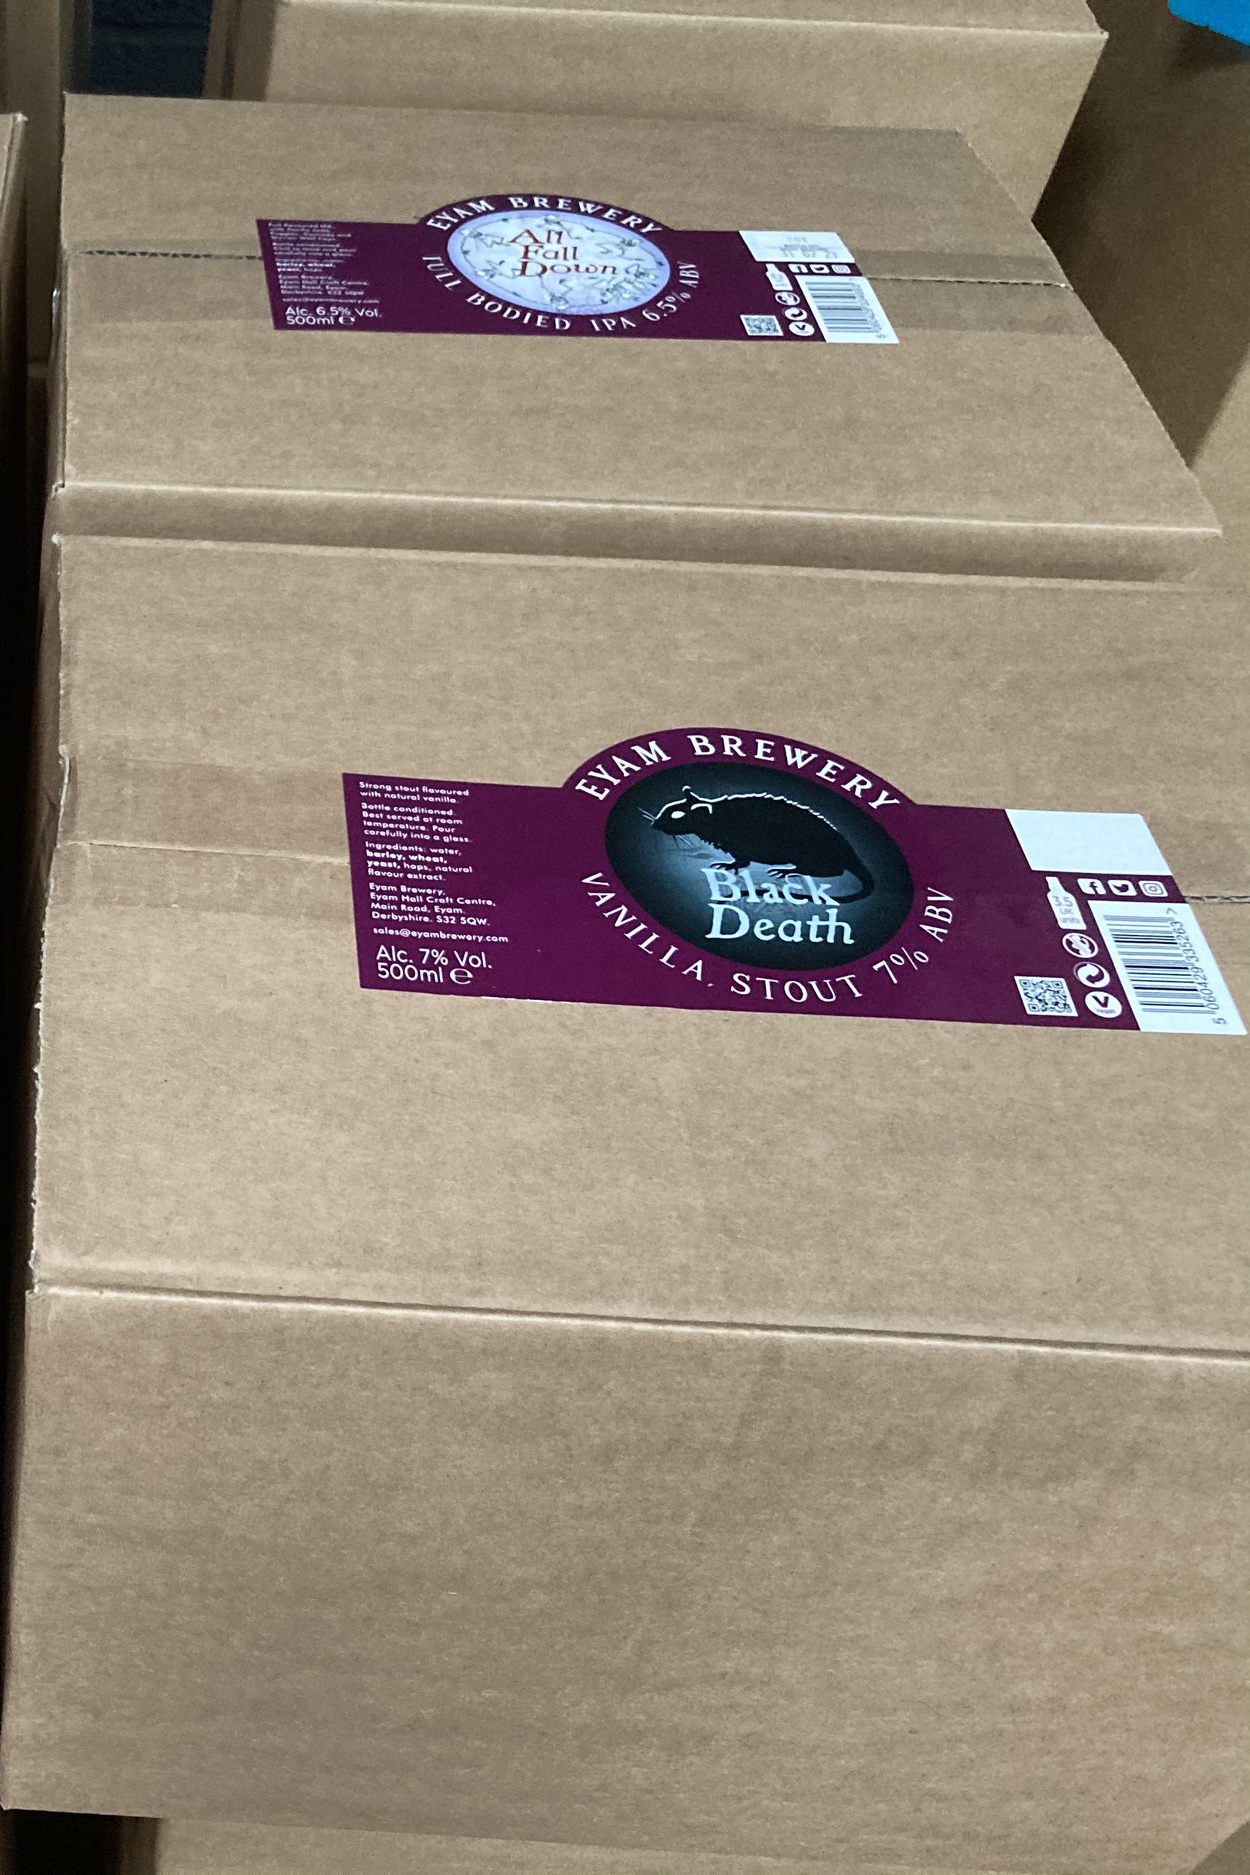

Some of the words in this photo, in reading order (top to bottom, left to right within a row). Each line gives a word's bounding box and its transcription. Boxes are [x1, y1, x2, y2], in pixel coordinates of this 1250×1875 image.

[426, 199, 495, 231] EYAM
[509, 197, 662, 234] BREWERY
[509, 229, 563, 244] All
[520, 245, 578, 260] Fall
[516, 261, 618, 277] Down
[466, 292, 571, 331] BODIED
[590, 316, 636, 331] IPA
[642, 290, 691, 322] 6.5%
[676, 261, 699, 288] ABV
[316, 306, 350, 316] 6.5%
[286, 316, 335, 325] 500ml
[575, 740, 672, 800] EYAM
[687, 734, 901, 811] BREWERY
[359, 781, 392, 792] Strong
[394, 785, 420, 793] stout
[422, 786, 470, 796] flavoured
[360, 790, 381, 798] with
[384, 792, 420, 801] natural
[361, 802, 391, 811] Bottle
[362, 810, 384, 819] Best
[386, 813, 420, 822] served
[364, 828, 408, 840] carefully
[410, 832, 431, 840] into
[432, 824, 456, 833] Pour
[368, 868, 404, 878] flavour
[435, 865, 473, 873] natural
[369, 883, 397, 892] Eyam
[701, 867, 841, 906] Black
[370, 892, 398, 902] Eyam
[401, 895, 423, 903] Hall
[426, 896, 453, 904] Craft
[371, 902, 397, 911] Main
[436, 915, 456, 924] S32
[705, 903, 854, 944] Death
[373, 927, 509, 943] sales@eyambrewery.com
[730, 972, 863, 1003] STOUT
[872, 946, 929, 984] 7%
[920, 887, 954, 942] ABV
[376, 945, 413, 964] Alc.
[419, 948, 448, 966] 7%
[454, 950, 492, 969] Vol.
[378, 962, 443, 983] 500ml
